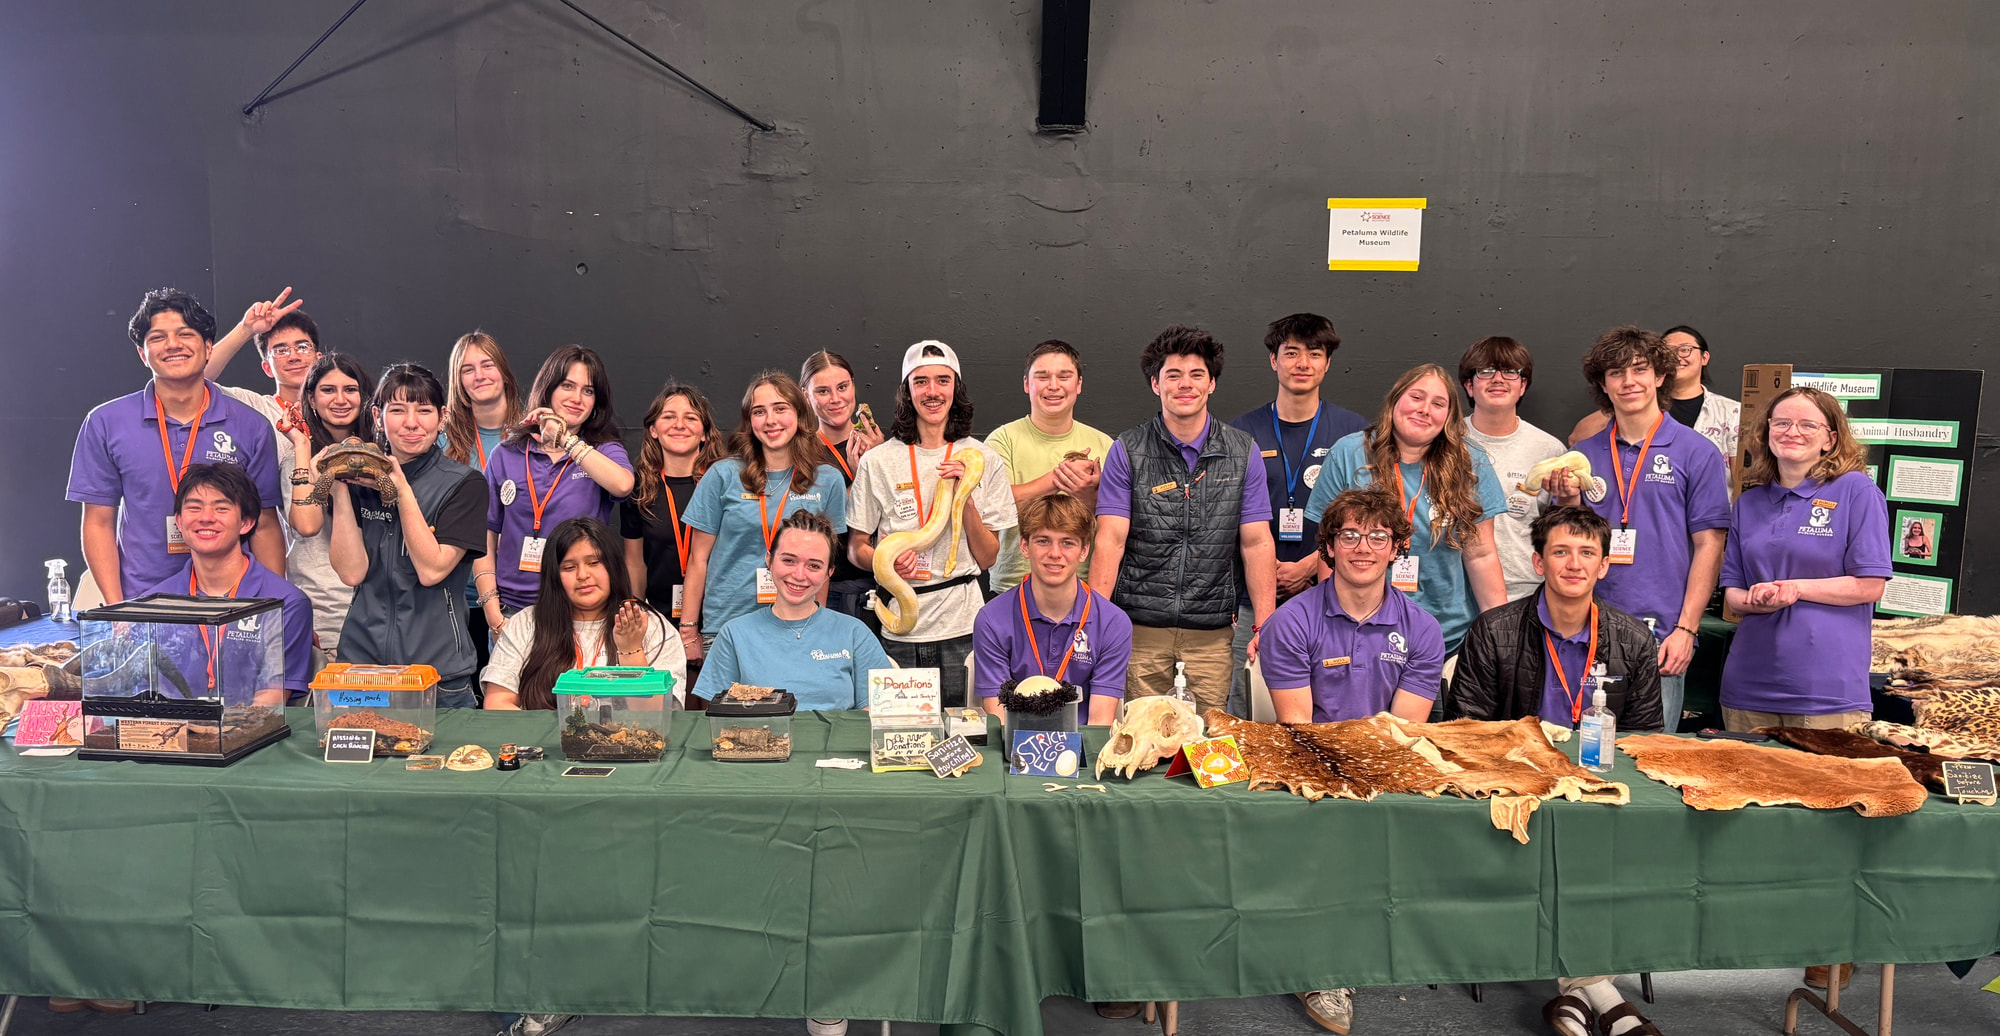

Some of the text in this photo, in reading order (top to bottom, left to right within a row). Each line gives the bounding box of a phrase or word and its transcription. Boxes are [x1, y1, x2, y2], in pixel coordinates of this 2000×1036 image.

[1342, 229, 1409, 237] Petaluma Wildlife
[1804, 381, 1876, 394] Wildlife Museum
[1859, 426, 1890, 436] Animal
[1894, 427, 1950, 440] Husbandry
[1798, 526, 1834, 534] PETALUMA
[884, 676, 933, 691] Donations
[886, 739, 926, 751] Donations
[1033, 741, 1066, 772] EGG
